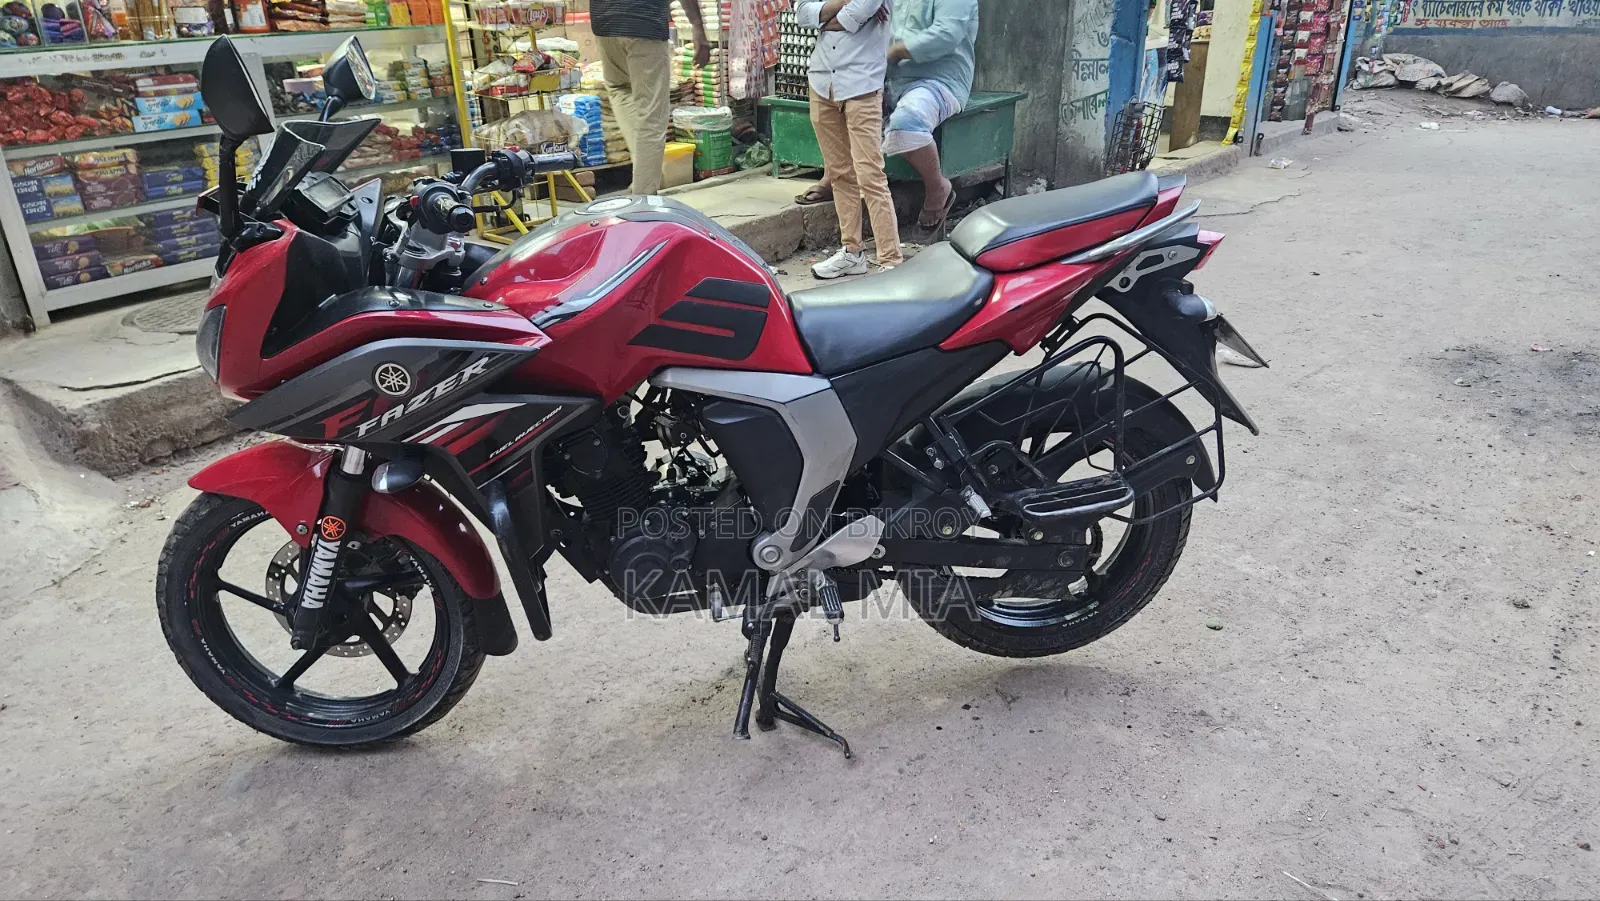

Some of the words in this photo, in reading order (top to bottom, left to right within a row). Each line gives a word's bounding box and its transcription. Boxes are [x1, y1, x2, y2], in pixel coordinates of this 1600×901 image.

[24, 159, 55, 176] Horlicks
[356, 356, 490, 438] FAZER
[489, 441, 514, 459] FUEL
[514, 405, 562, 442] INJECTION
[301, 538, 341, 609] YAMAHA
[409, 555, 435, 593] YAMAHA
[200, 637, 226, 675] YAMAHA
